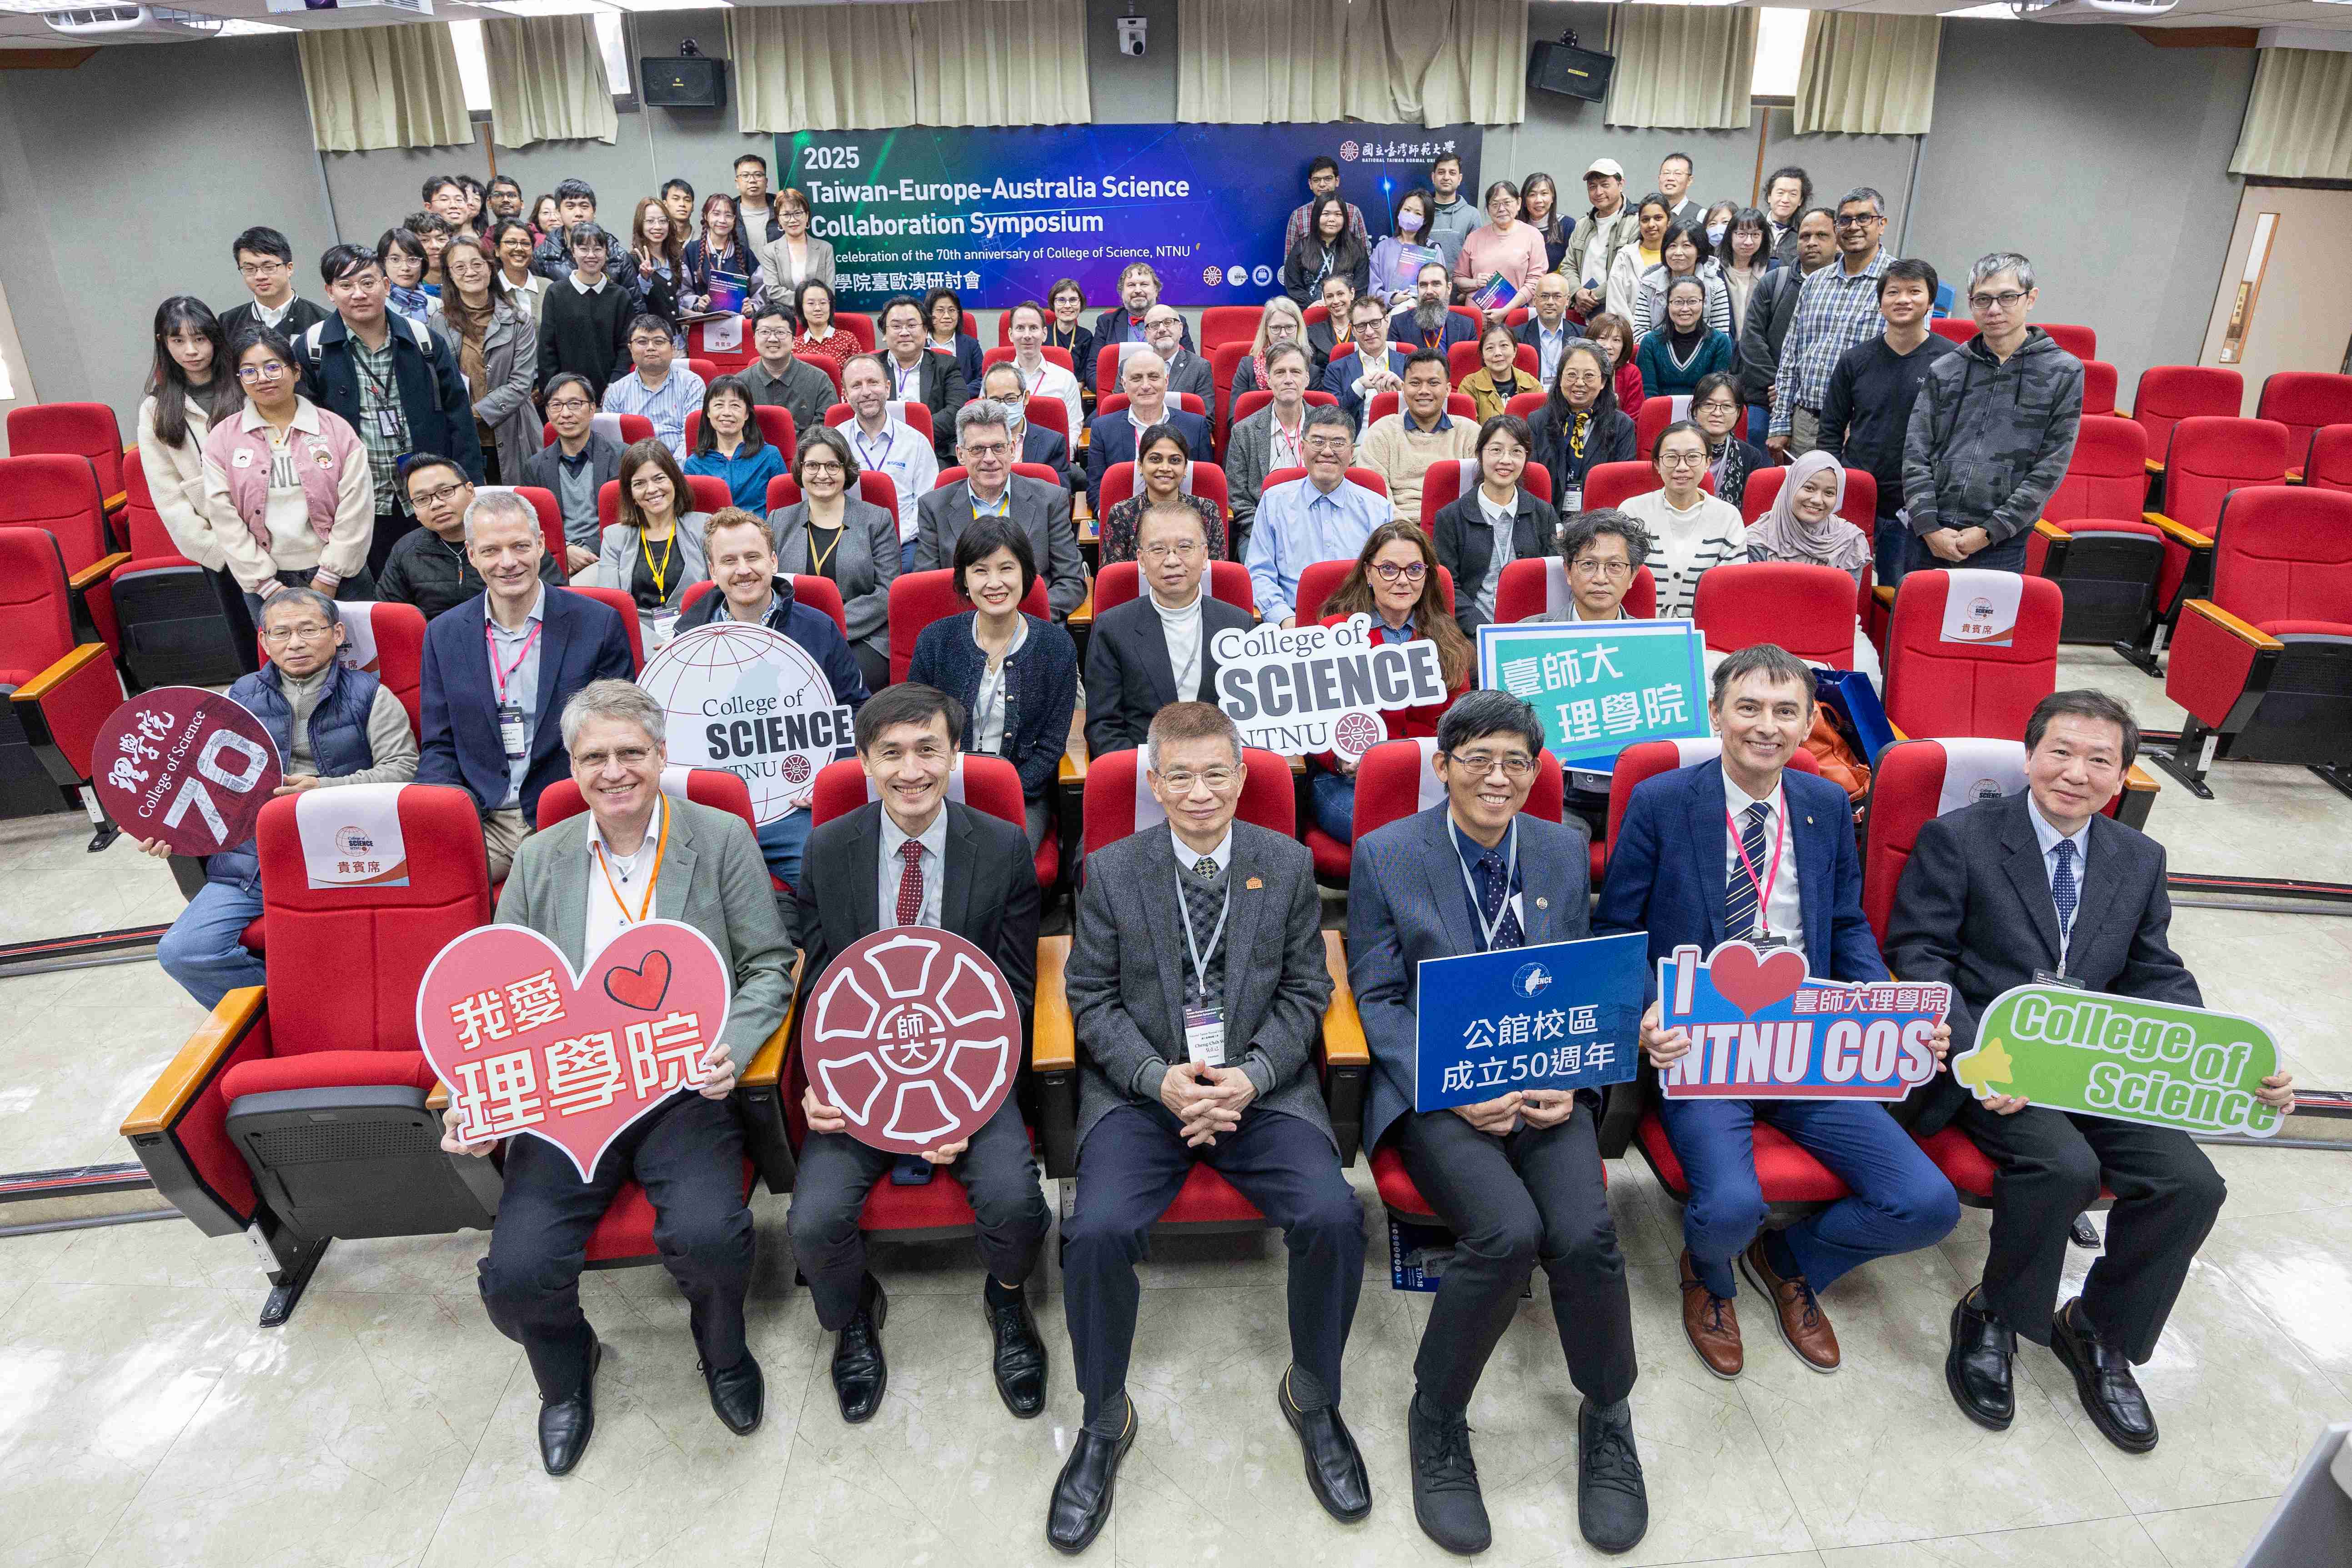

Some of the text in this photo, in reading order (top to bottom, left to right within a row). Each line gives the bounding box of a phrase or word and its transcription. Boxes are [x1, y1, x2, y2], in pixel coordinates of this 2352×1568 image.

[804, 146, 859, 169] 2025
[1362, 140, 1455, 157] 國立臺灣師範大學
[807, 175, 1189, 205] Taiwan-Europe-Australia Science
[811, 211, 1103, 238] Collaboration Symposium
[836, 245, 1190, 262] celebration of the 70th anniversary of College of Science, NTNU
[836, 271, 981, 292] 學院臺歐澳研討會
[1218, 620, 1364, 657] College of
[1961, 624, 1992, 634] 貴賓席
[1223, 646, 1439, 721] SCIENCE
[1501, 643, 1623, 698] 臺師大
[702, 688, 804, 717] College of
[1556, 683, 1688, 743] 理學院
[109, 710, 175, 794] 理學院
[706, 709, 852, 760] SCIENCE
[138, 711, 206, 818] College of Science
[162, 729, 269, 847] 70
[722, 761, 777, 779] TNU
[337, 861, 380, 873] 貴賓席
[1674, 952, 1696, 1015] I
[1794, 989, 1947, 1013] 臺師大理學院
[453, 969, 565, 1049] 我愛
[1463, 1004, 1599, 1050] 公館校區
[897, 1013, 927, 1063] 師大
[1668, 1020, 1934, 1086] NTNU COS
[2015, 997, 2251, 1086] College of
[455, 1012, 709, 1138] 理學院
[1441, 1042, 1615, 1093] 成立50週年
[2089, 1064, 2278, 1132] Science
